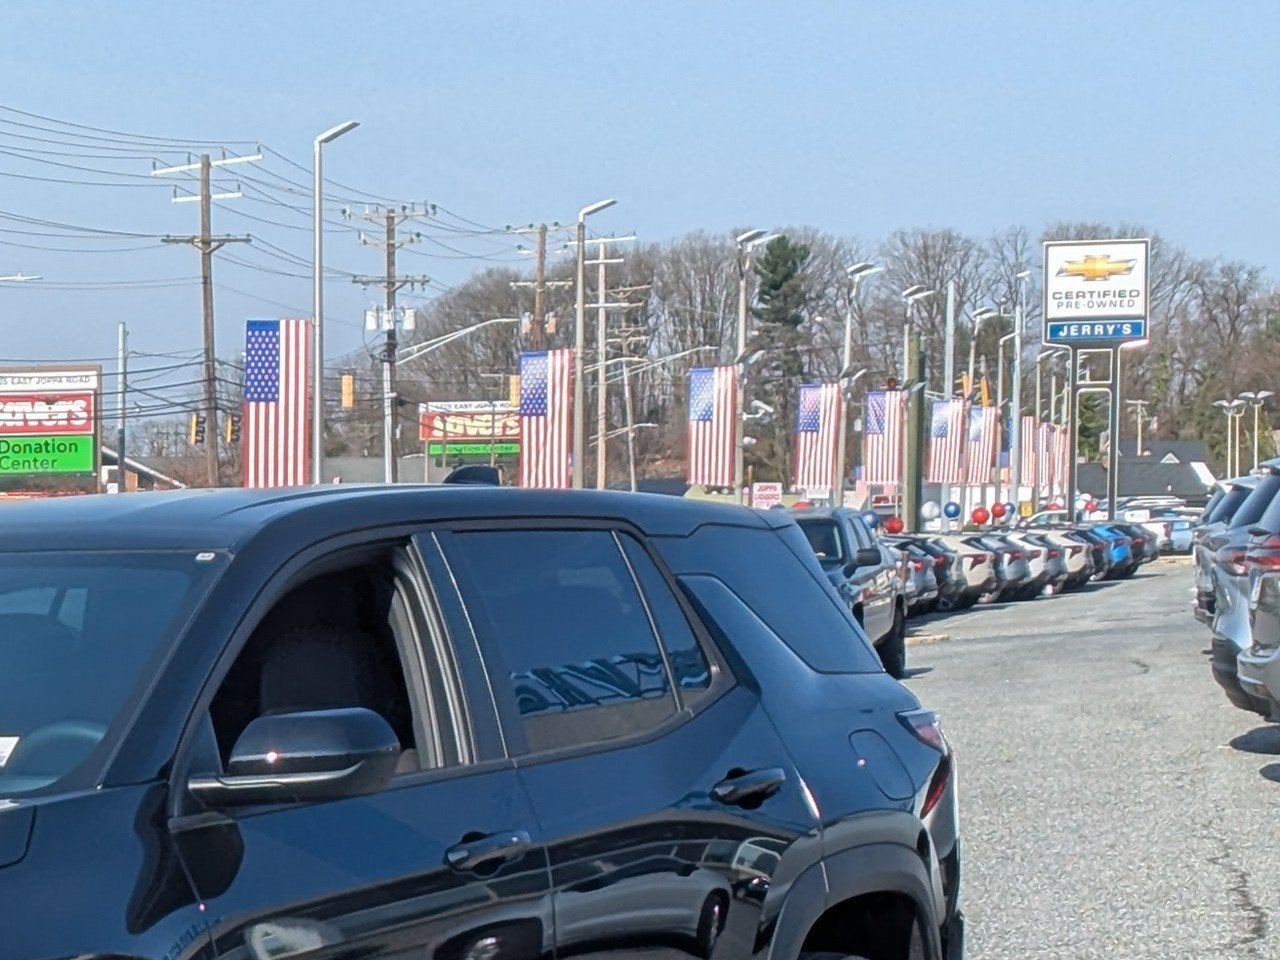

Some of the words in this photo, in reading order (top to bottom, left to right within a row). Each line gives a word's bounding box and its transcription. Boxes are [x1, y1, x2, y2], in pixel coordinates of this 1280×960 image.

[1052, 289, 1140, 300] CERTIFIED
[1057, 299, 1135, 309] PRE-OWNED
[1059, 323, 1132, 337] JERRY'S
